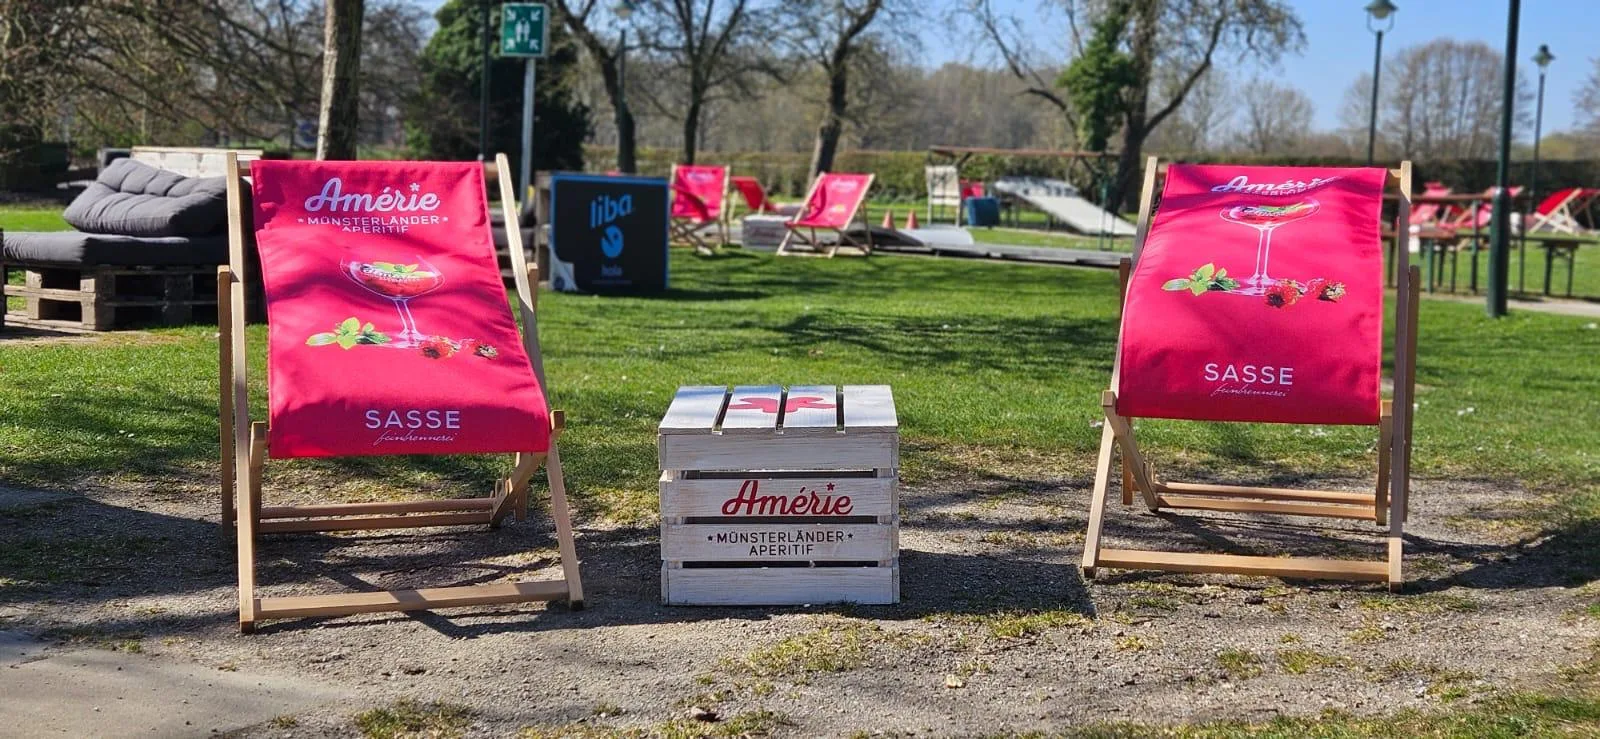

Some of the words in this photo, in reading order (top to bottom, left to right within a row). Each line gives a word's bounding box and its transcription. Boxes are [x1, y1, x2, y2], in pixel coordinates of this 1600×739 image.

[304, 177, 441, 212] Amérie
[590, 193, 633, 229] liba
[1204, 363, 1294, 385] SASSE
[365, 409, 461, 429] SASSE
[721, 479, 854, 516] Amérie
[716, 530, 845, 544] MÜNSTERLÄNDER
[749, 544, 815, 557] APERITIF
